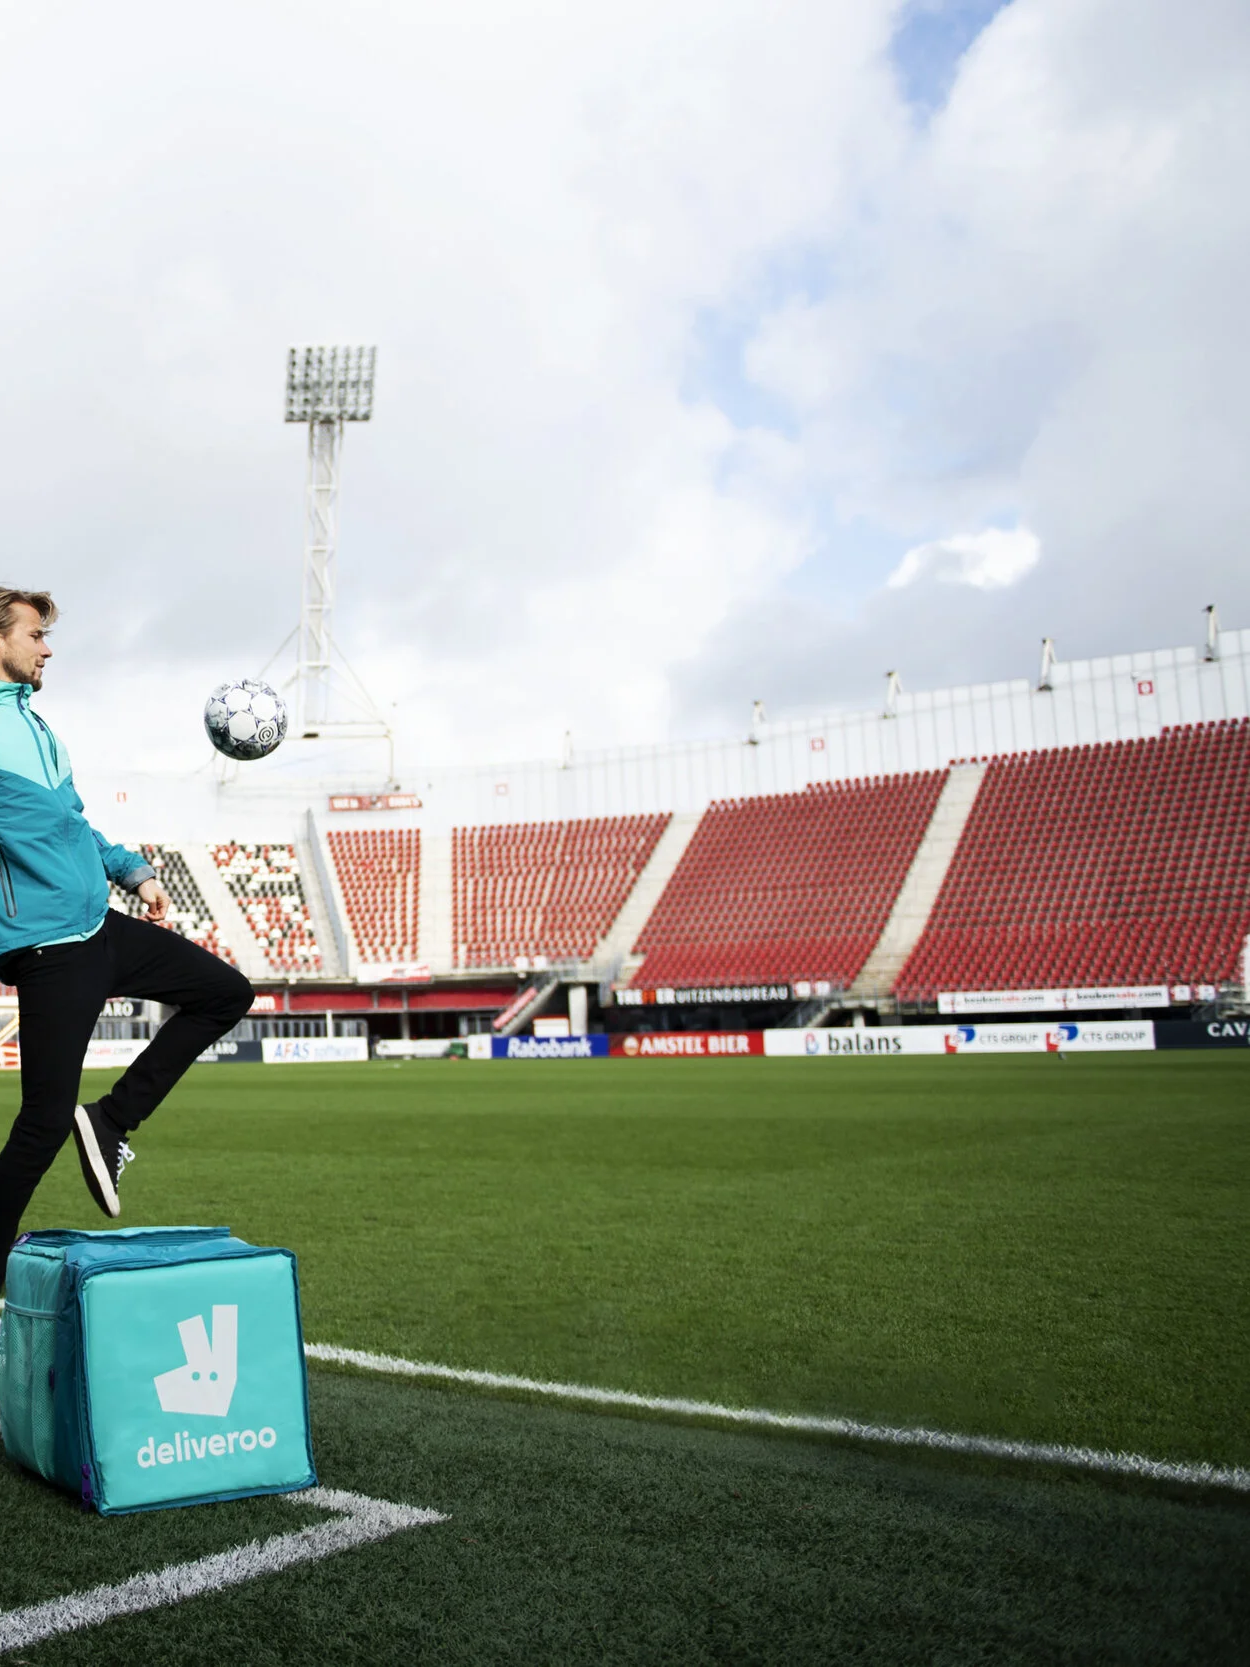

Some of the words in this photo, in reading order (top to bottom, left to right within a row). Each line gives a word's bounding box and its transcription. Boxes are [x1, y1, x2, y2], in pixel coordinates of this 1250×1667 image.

[616, 988, 674, 1005] TREFFER
[1105, 1032, 1146, 1042] GROUP
[1207, 1022, 1250, 1037] CAV
[274, 1043, 310, 1059] AFAS
[507, 1037, 592, 1058] Rabobank
[640, 1036, 705, 1055] AMSTEL
[707, 1035, 750, 1053] BIER
[827, 1034, 903, 1055] balans
[137, 1426, 277, 1468] deliveroo
